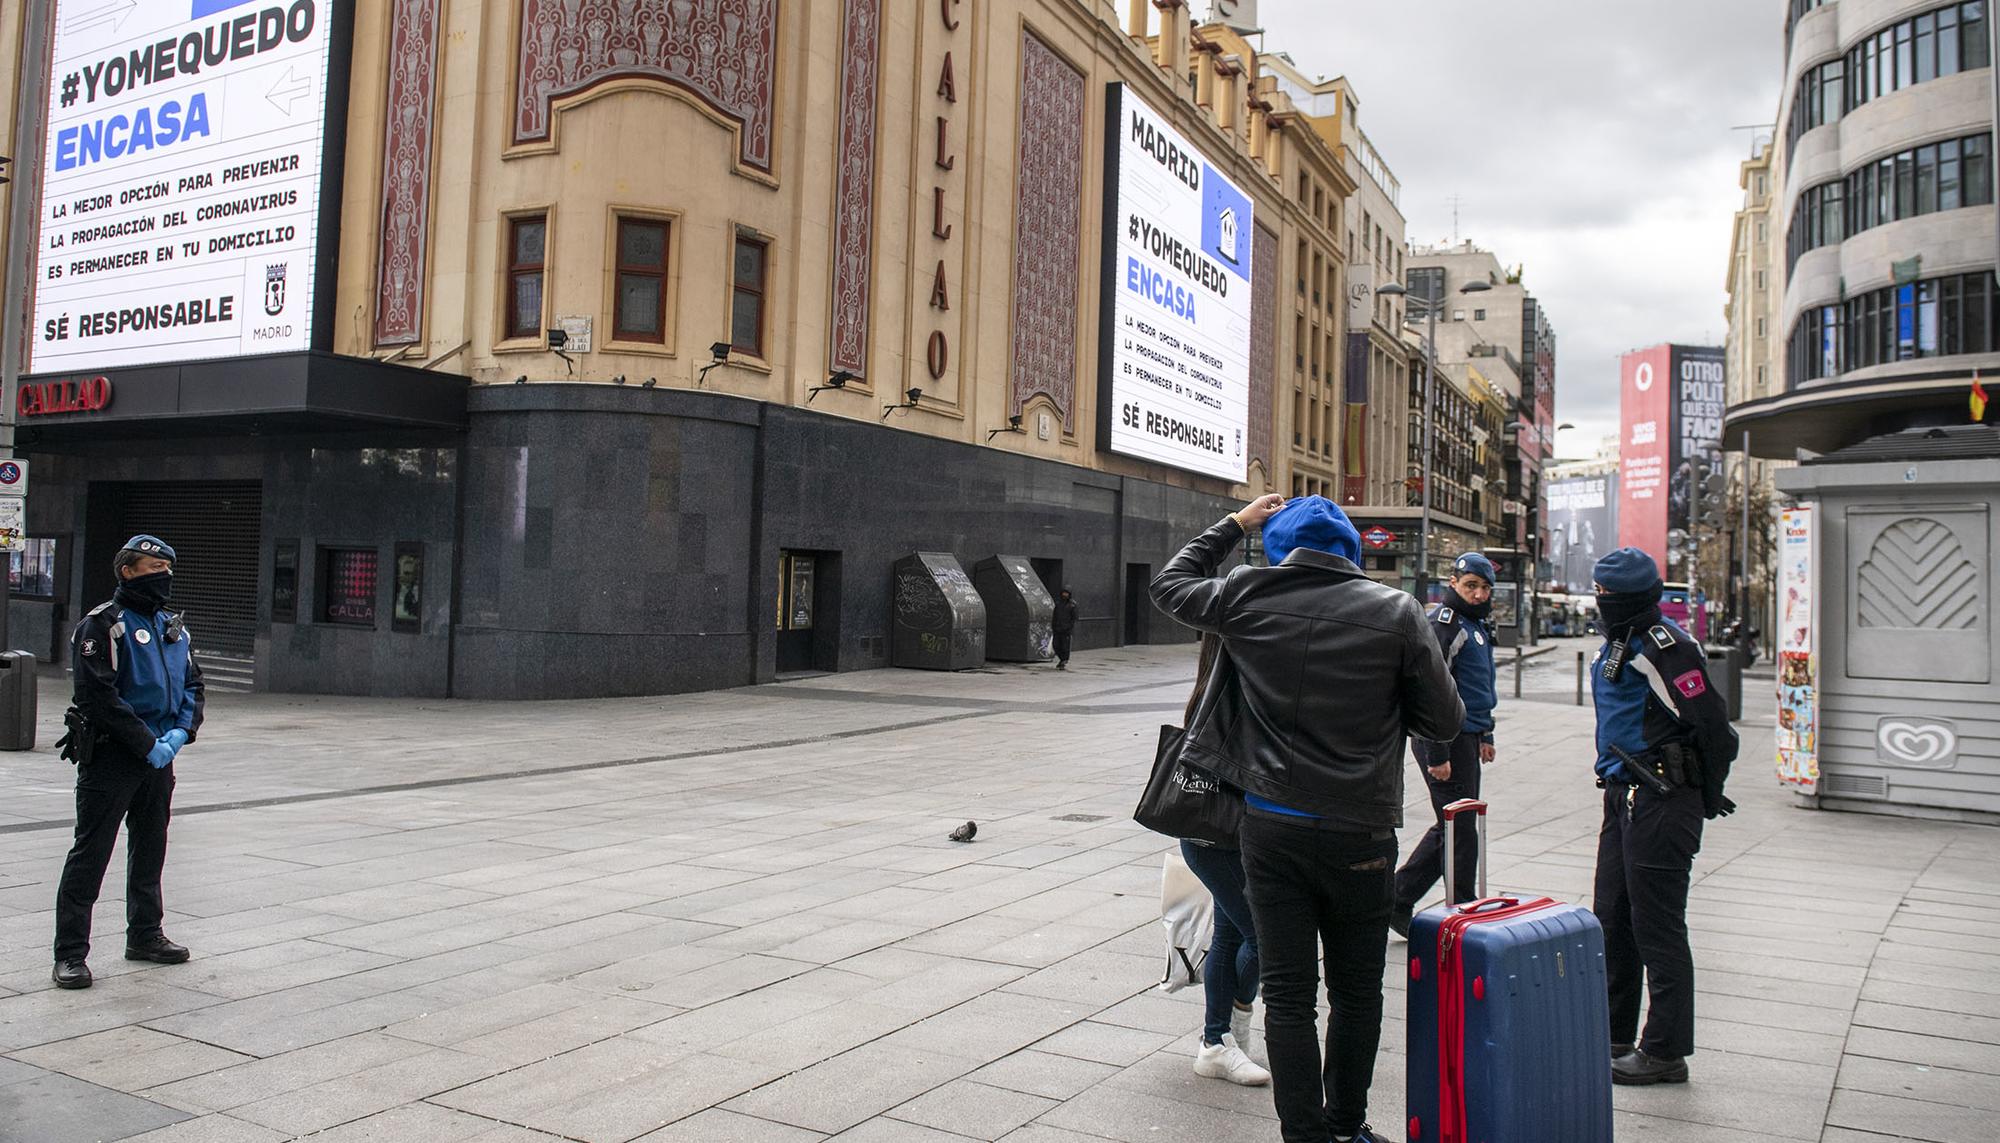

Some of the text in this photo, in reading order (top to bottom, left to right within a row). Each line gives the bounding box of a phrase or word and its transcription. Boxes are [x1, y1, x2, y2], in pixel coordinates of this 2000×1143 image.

[60, 0, 315, 108] #YOMEQUEDO
[55, 92, 210, 172] ENCASA
[1131, 109, 1199, 192] MADRID
[53, 154, 300, 219] LA MEJOR OPCIÓN PARA PREVENIR
[50, 190, 298, 249] LA PROPAGACIÓN DEL CORONAVIRUS
[48, 225, 295, 279] ES PERMANECER EN TU DOMICILIO
[1129, 213, 1228, 299] #YOMEQUEDO
[1127, 255, 1196, 325] ENCASA
[44, 295, 234, 342] SÉ RESPONSABLE
[252, 324, 293, 342] MADRID
[1125, 314, 1134, 328] LA
[1136, 320, 1156, 339] MEJOR
[1183, 343, 1196, 357] PARA
[1199, 351, 1223, 370] PREVENIR
[1123, 362, 1132, 375] ES
[1135, 367, 1172, 391] PERMANECER
[1175, 383, 1183, 395] EN
[1185, 387, 1193, 398] TU
[1124, 338, 1133, 351] LA
[1177, 362, 1188, 375] DEL
[1681, 360, 1723, 382] OTRO
[17, 375, 111, 416] CALLAO
[1682, 401, 1705, 416] QUE
[1122, 402, 1224, 455] SÉ RESPONSABLE
